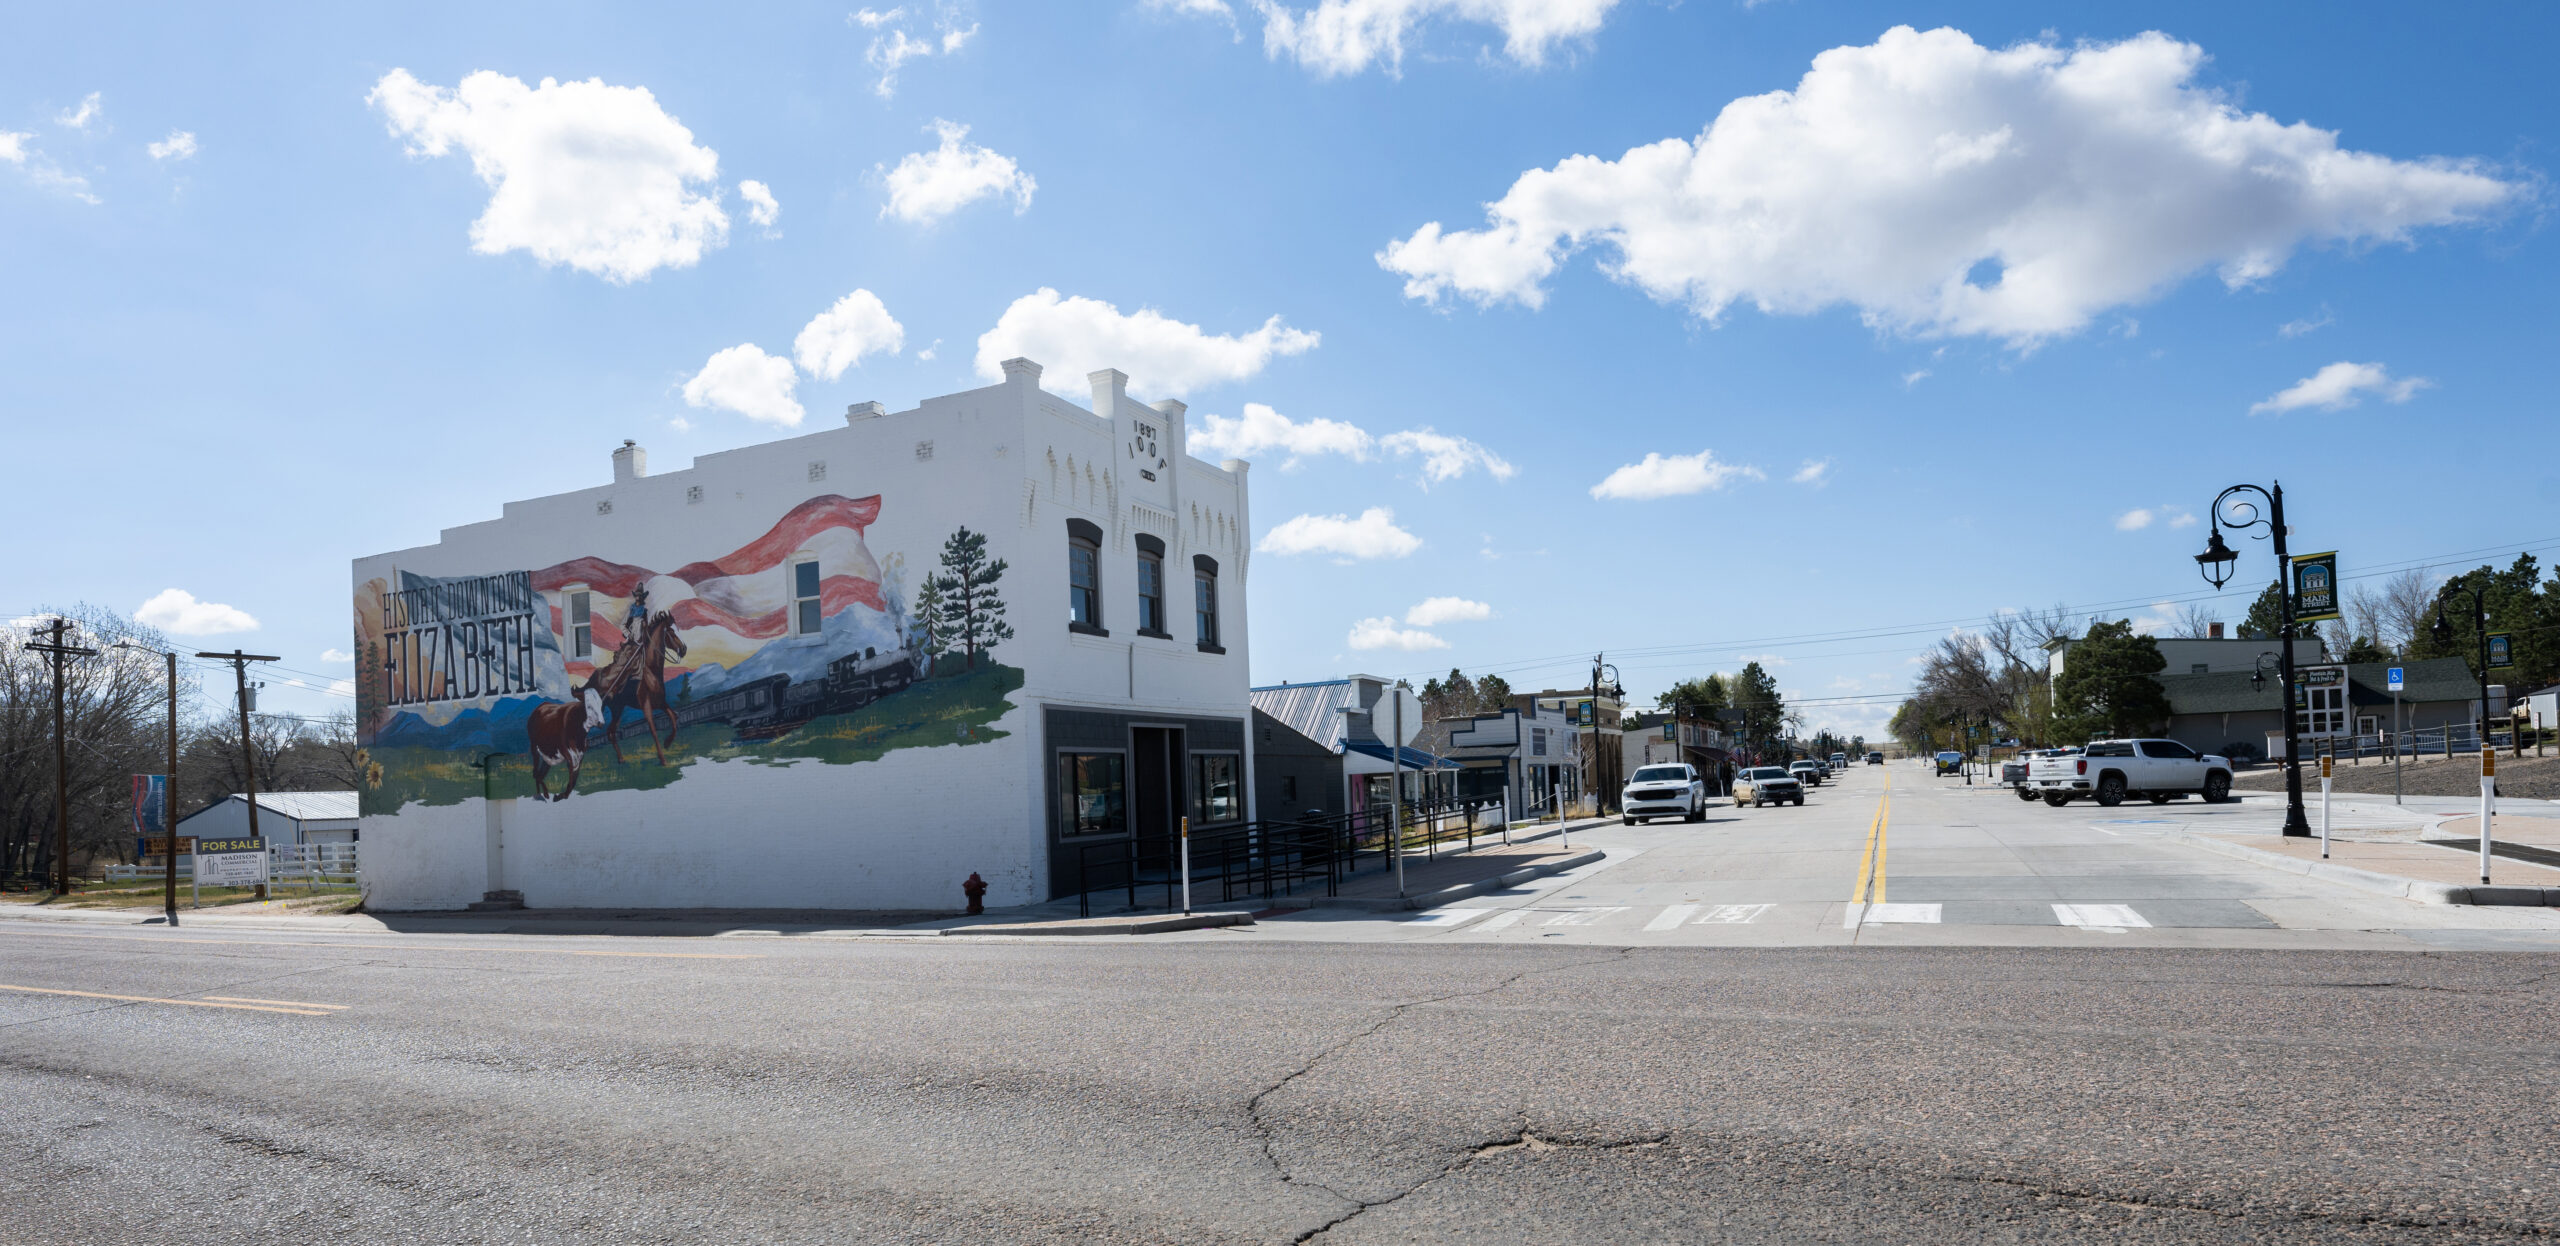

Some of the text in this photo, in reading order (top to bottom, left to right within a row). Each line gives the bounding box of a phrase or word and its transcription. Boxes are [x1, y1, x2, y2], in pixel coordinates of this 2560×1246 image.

[1134, 420, 1156, 440] 1887
[383, 570, 534, 630] HISTORIC DOWNTOWN
[2302, 595, 2330, 603] MAIN
[384, 613, 538, 705] ELIZABETH
[202, 841, 227, 851] FOR
[231, 840, 260, 850] SALE
[221, 853, 258, 861] MADISON
